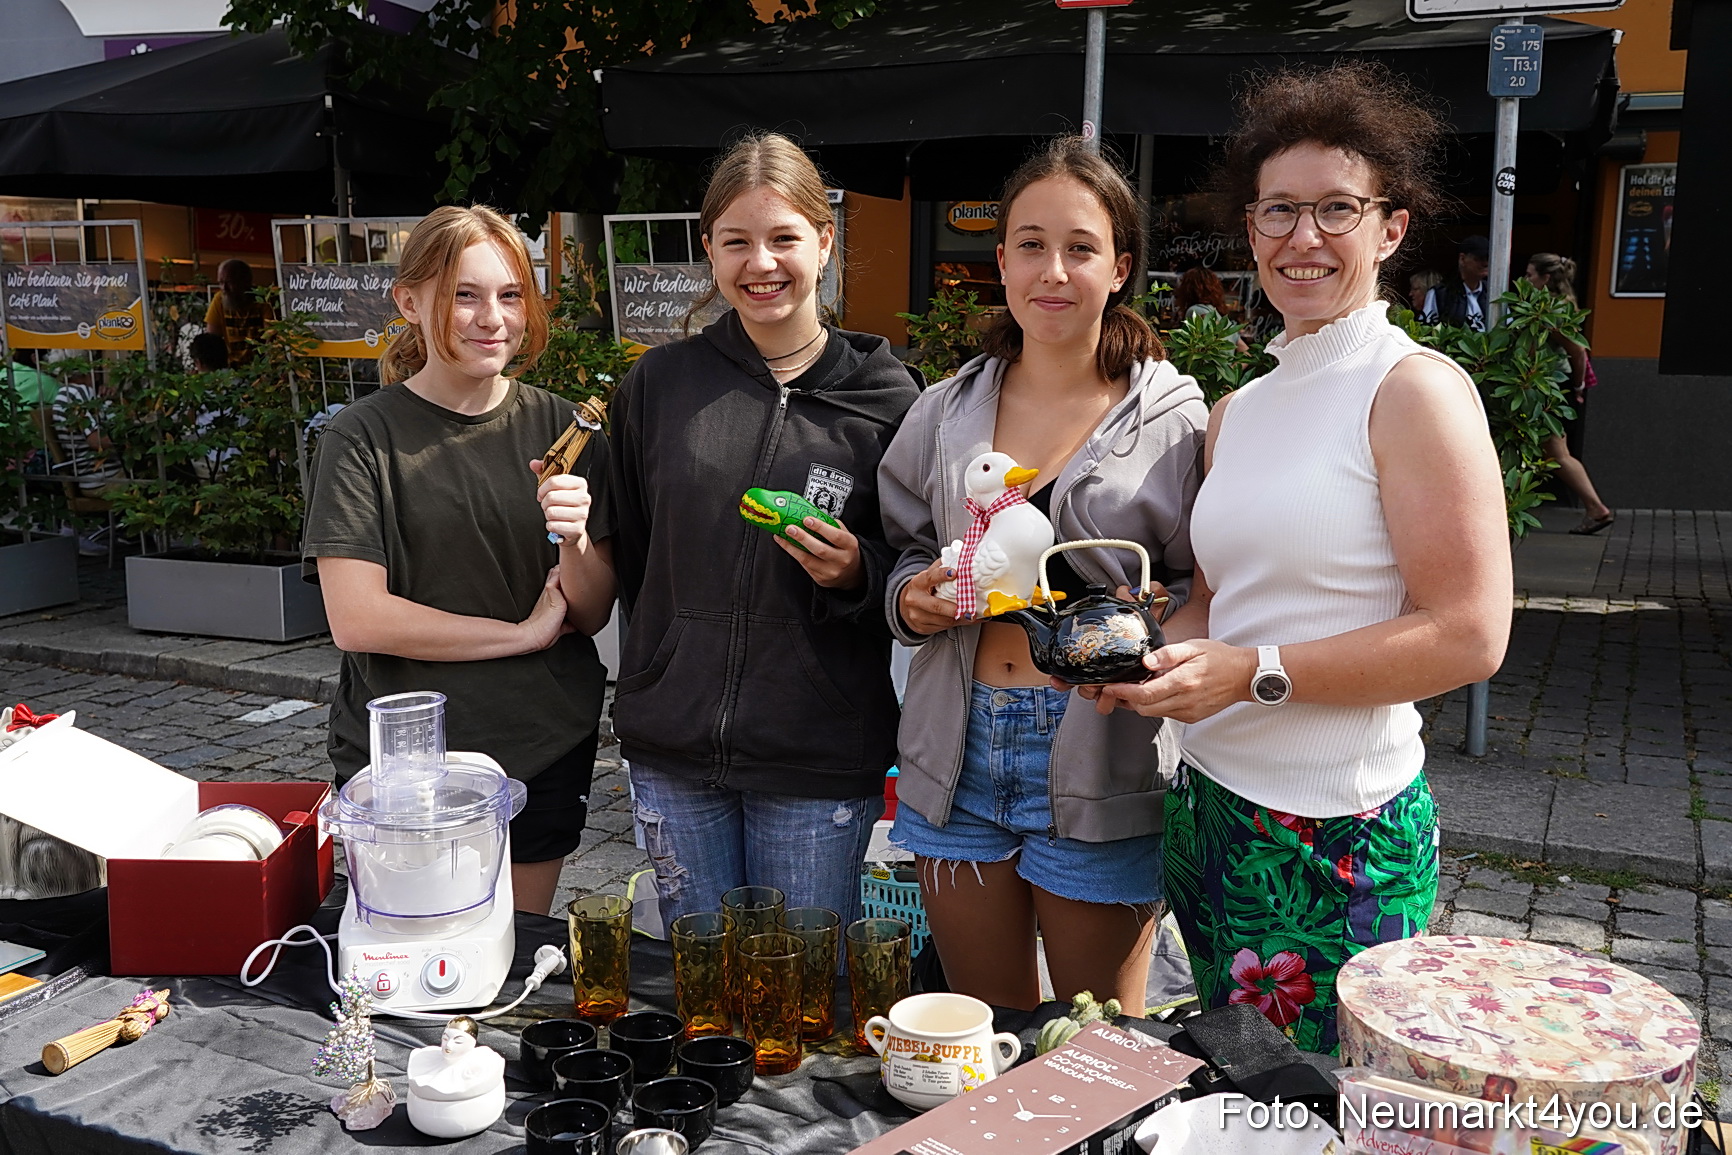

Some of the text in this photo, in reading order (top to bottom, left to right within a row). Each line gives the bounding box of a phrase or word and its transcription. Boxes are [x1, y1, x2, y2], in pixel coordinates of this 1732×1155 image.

[1493, 35, 1540, 51] S 175
[1630, 175, 1646, 185] Hol
[1648, 175, 1661, 185] dir
[1629, 187, 1662, 197] deinen
[952, 203, 994, 224] plank
[215, 212, 255, 242] 30%
[7, 270, 129, 295] Wir bedienen Sie gerne!
[289, 273, 309, 290] Wir
[311, 272, 359, 290] bedienen
[361, 274, 380, 290] Sie
[624, 274, 650, 293] Wir
[8, 293, 59, 309] Café Plank
[291, 297, 344, 313] Café Plank
[625, 301, 656, 320] Café
[99, 316, 123, 330] plank
[813, 467, 828, 477] die
[362, 951, 410, 961] Moulinex
[932, 1043, 983, 1064] SUPPE
[1043, 1058, 1095, 1084] WANDUHR
[1051, 1054, 1138, 1092] DO-IT-YOURSELF-
[1049, 1094, 1065, 1104] 12
[1056, 1126, 1069, 1134] 3
